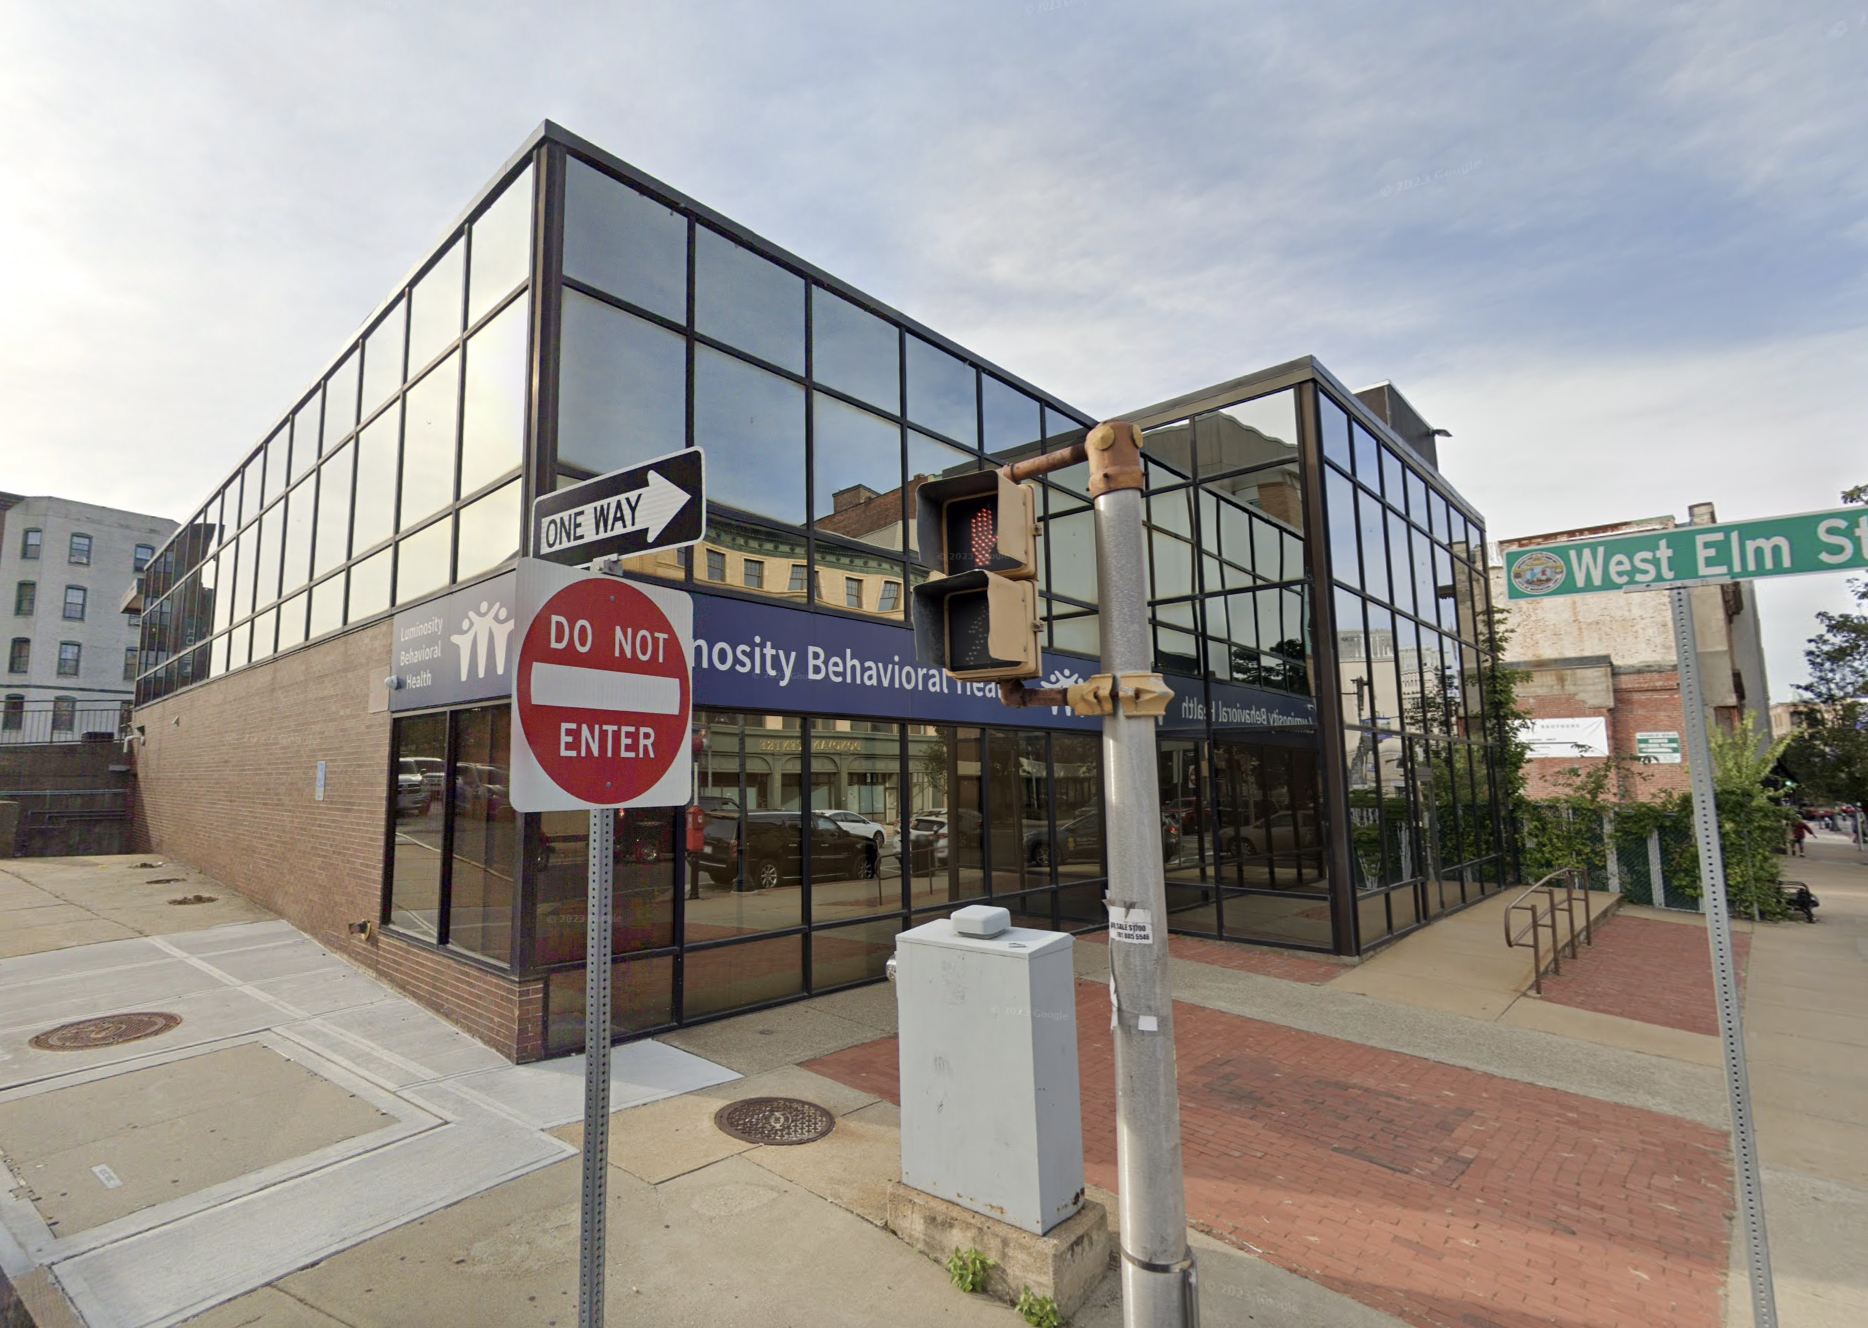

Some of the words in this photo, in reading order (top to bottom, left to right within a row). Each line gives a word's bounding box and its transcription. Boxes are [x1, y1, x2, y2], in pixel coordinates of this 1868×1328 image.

[545, 510, 585, 549] ONE
[593, 493, 643, 535] WAY
[1569, 539, 1674, 588] West
[1695, 531, 1791, 576] Elm
[400, 617, 443, 642] Luminosity
[550, 614, 593, 653] DO
[614, 625, 669, 664] NOT
[400, 640, 442, 666] Behavioral
[691, 635, 797, 687] nosity
[807, 645, 949, 695] Behavioral
[406, 669, 432, 690] Health
[559, 722, 656, 759] ENTER
